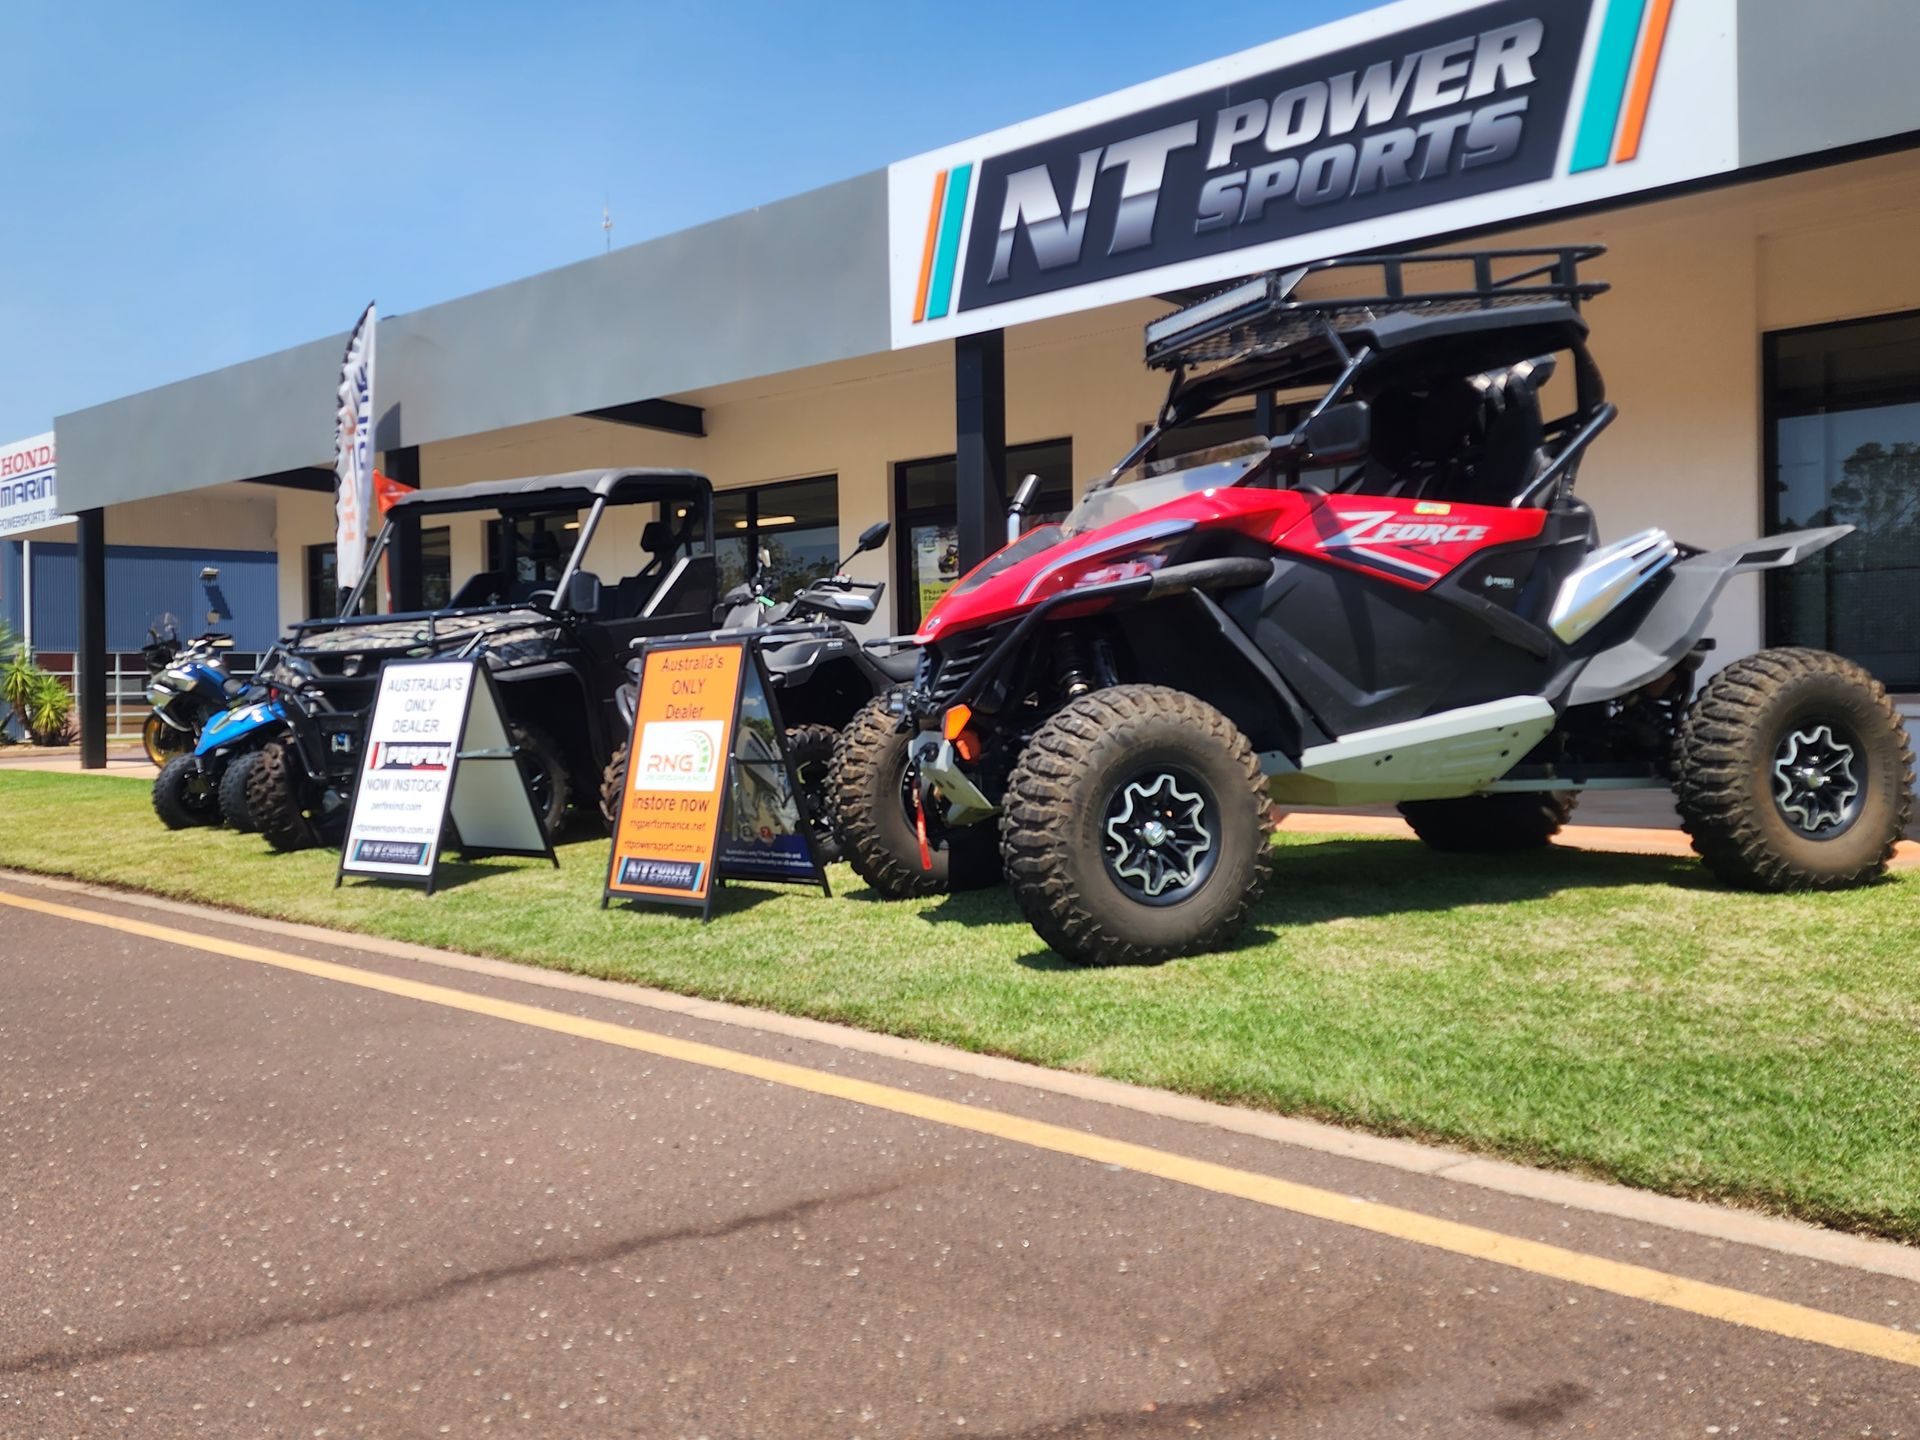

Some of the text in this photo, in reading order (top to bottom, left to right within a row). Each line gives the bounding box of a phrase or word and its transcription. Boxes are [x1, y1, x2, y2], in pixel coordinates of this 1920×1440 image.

[988, 17, 1545, 287] NT POWER
[1194, 95, 1529, 235] SPORTS
[1, 475, 57, 508] MARIN
[661, 654, 724, 672] Australia's
[387, 677, 463, 692] AUSTRALIA'S
[671, 678, 707, 696] ONLY
[404, 698, 436, 713] ONLY
[665, 703, 704, 719] Dealer
[392, 719, 440, 733] DEALER
[646, 754, 694, 773] RNG
[365, 778, 442, 793] NOW INSTOCK
[632, 793, 710, 812] instore now
